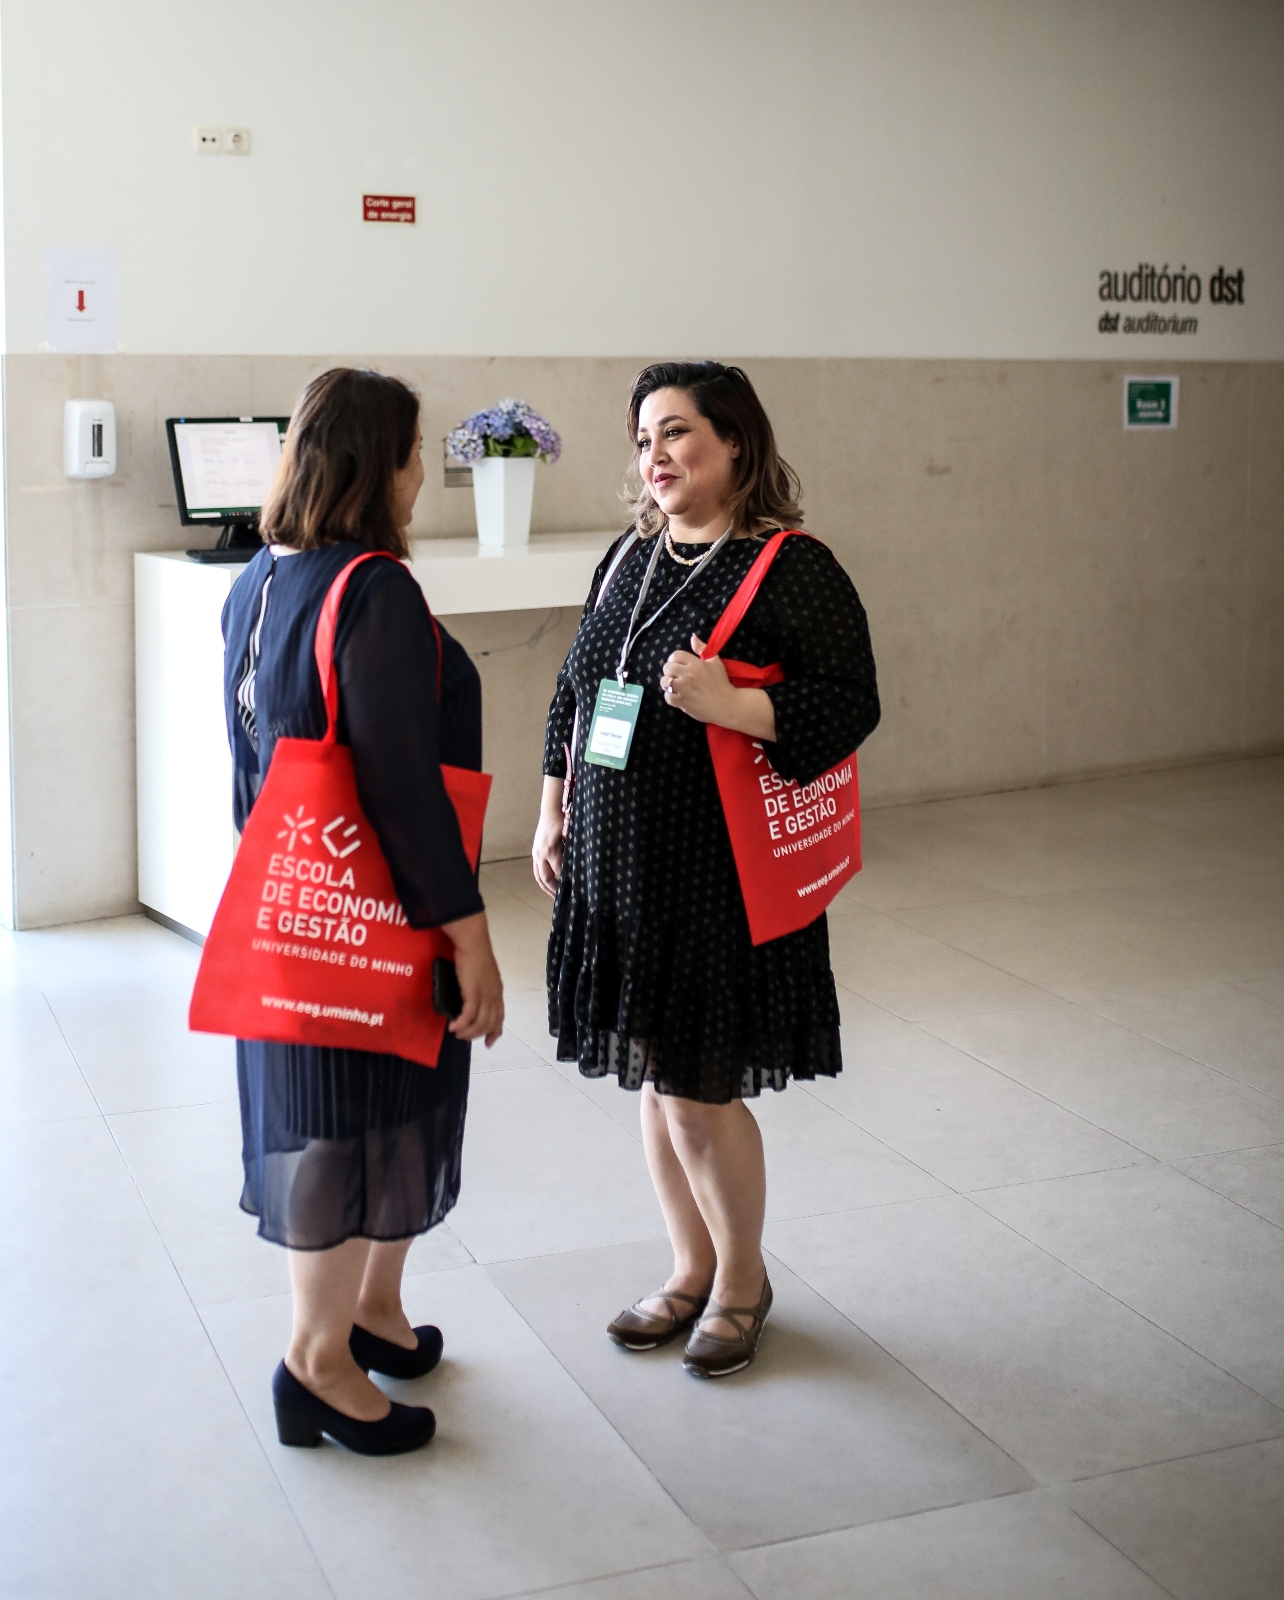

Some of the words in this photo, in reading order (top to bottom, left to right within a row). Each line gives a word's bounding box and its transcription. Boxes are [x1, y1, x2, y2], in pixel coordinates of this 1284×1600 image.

[366, 198, 389, 208] Corte
[391, 200, 413, 210] geral
[367, 210, 378, 219] de
[380, 212, 412, 222] energia
[1099, 263, 1201, 304] auditório
[1210, 265, 1244, 304] dst
[1099, 311, 1119, 333] dst
[1123, 312, 1198, 334] auditorium
[764, 793, 790, 818] DE
[792, 764, 852, 808] ECONOMIA
[768, 820, 782, 840] E
[785, 797, 837, 835] GESTÃO
[773, 826, 832, 858] UNIVERSIDADE
[833, 818, 842, 833] DO
[267, 853, 356, 891] ESCOLA
[261, 880, 294, 906] DE
[256, 906, 273, 931] E
[277, 911, 368, 947] GESTÃO
[251, 938, 346, 966] UNIVERSIDADE
[350, 953, 368, 969] DO
[371, 957, 414, 978] MINHO
[261, 994, 385, 1028] www.eeg.uminho.pt
